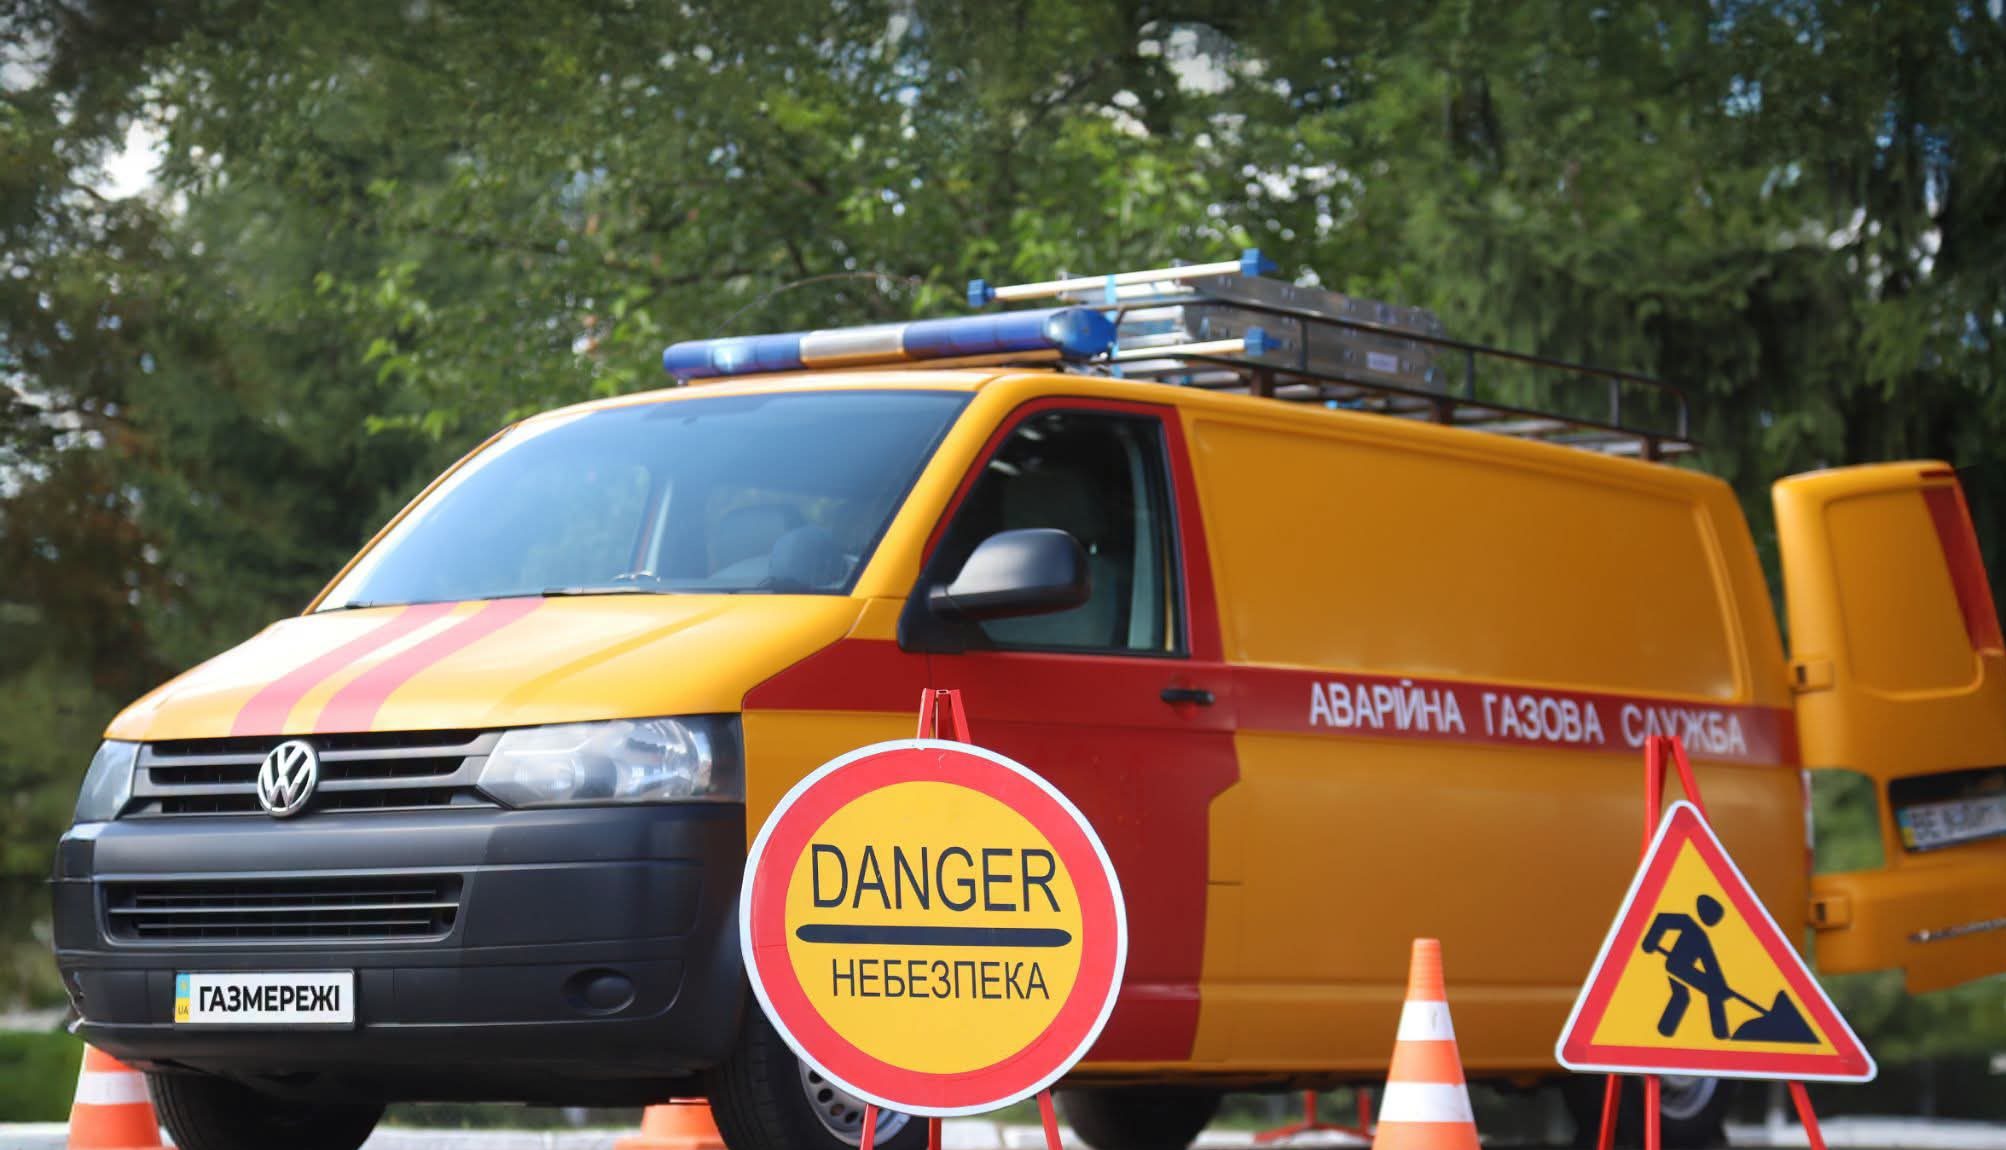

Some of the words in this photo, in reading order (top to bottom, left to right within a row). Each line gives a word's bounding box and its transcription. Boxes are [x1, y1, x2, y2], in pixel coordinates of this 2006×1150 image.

[1310, 679, 1466, 733] АВАРІЙНА
[1482, 692, 1605, 743] ГАЗОВА
[811, 844, 1061, 912] DANGER
[199, 985, 341, 1012] ГАЗМЕРЕЖІ
[832, 958, 1050, 1000] НЕБЕЗПЕКА
[178, 1004, 189, 1015] UA
